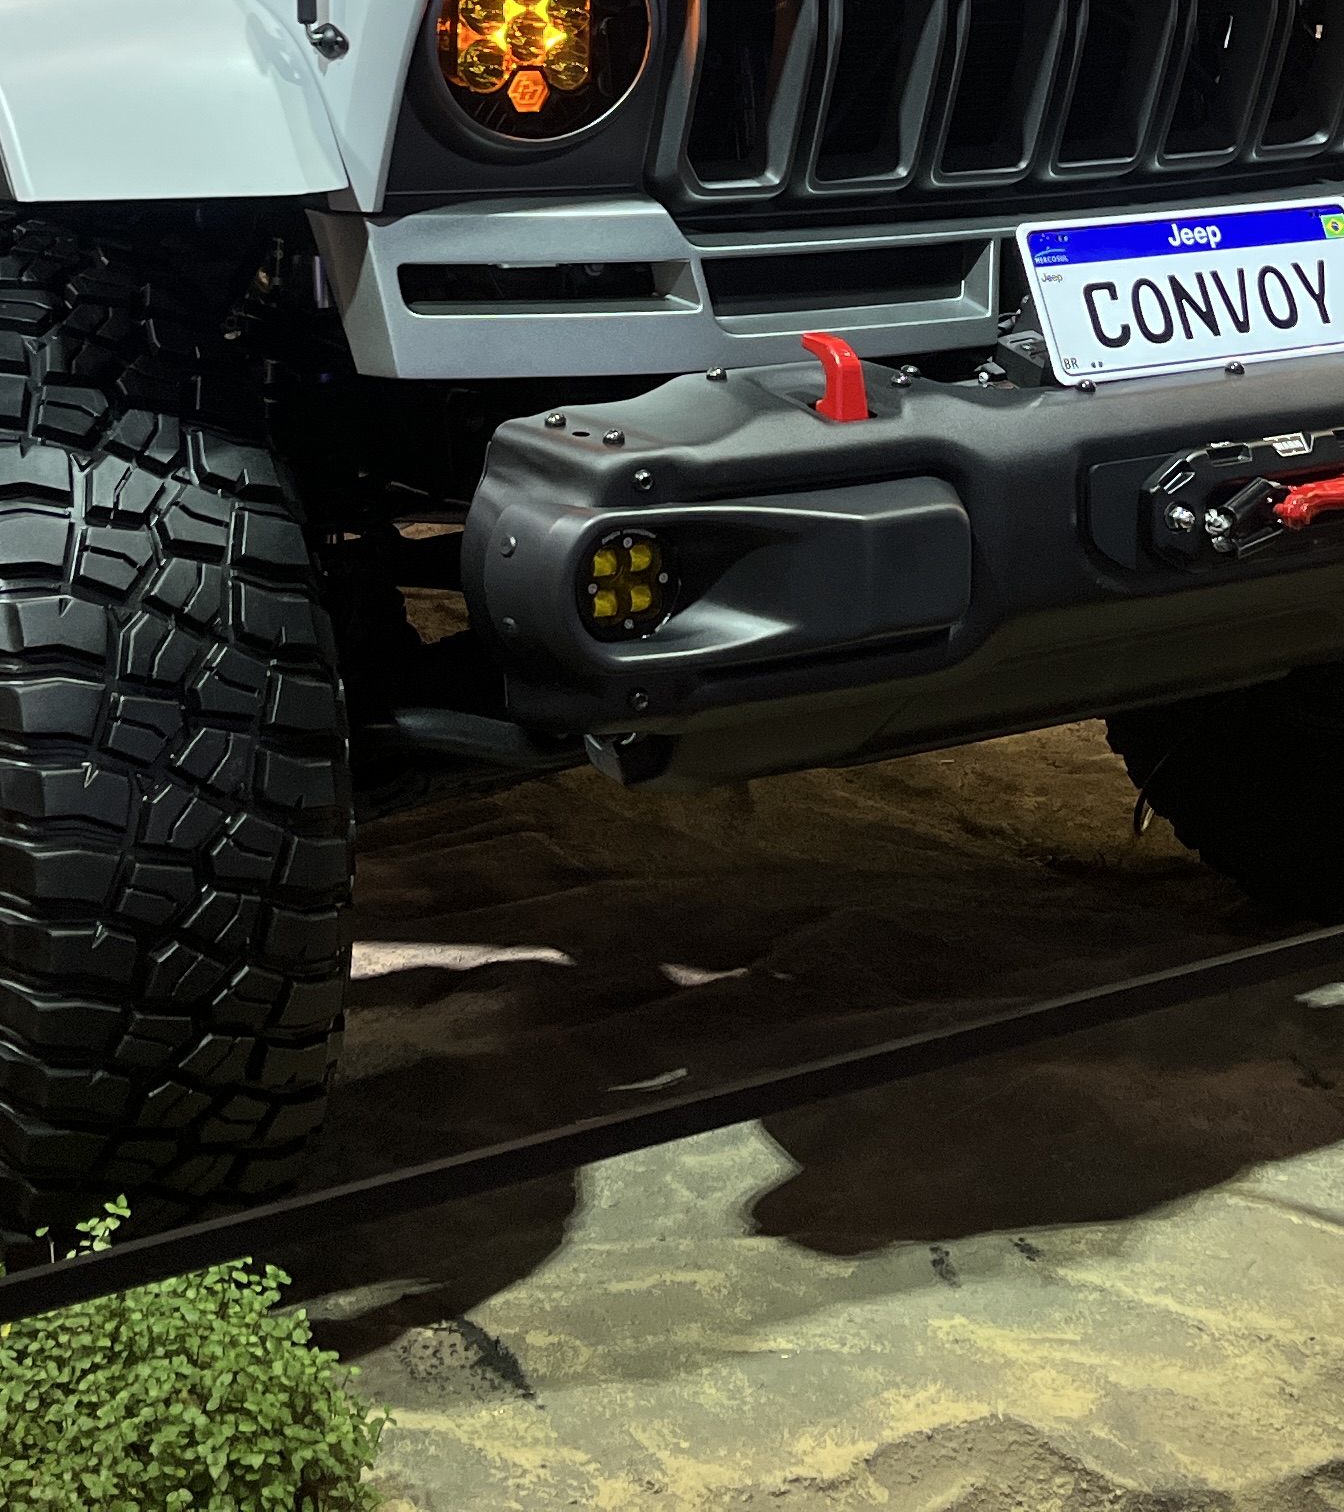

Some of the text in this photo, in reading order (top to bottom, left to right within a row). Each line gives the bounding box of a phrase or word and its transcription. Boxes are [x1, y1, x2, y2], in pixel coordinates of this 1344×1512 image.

[1167, 223, 1222, 248] Jeep
[1041, 273, 1063, 283] Jeep
[1083, 260, 1331, 348] CONVOY
[1063, 357, 1080, 369] BR
